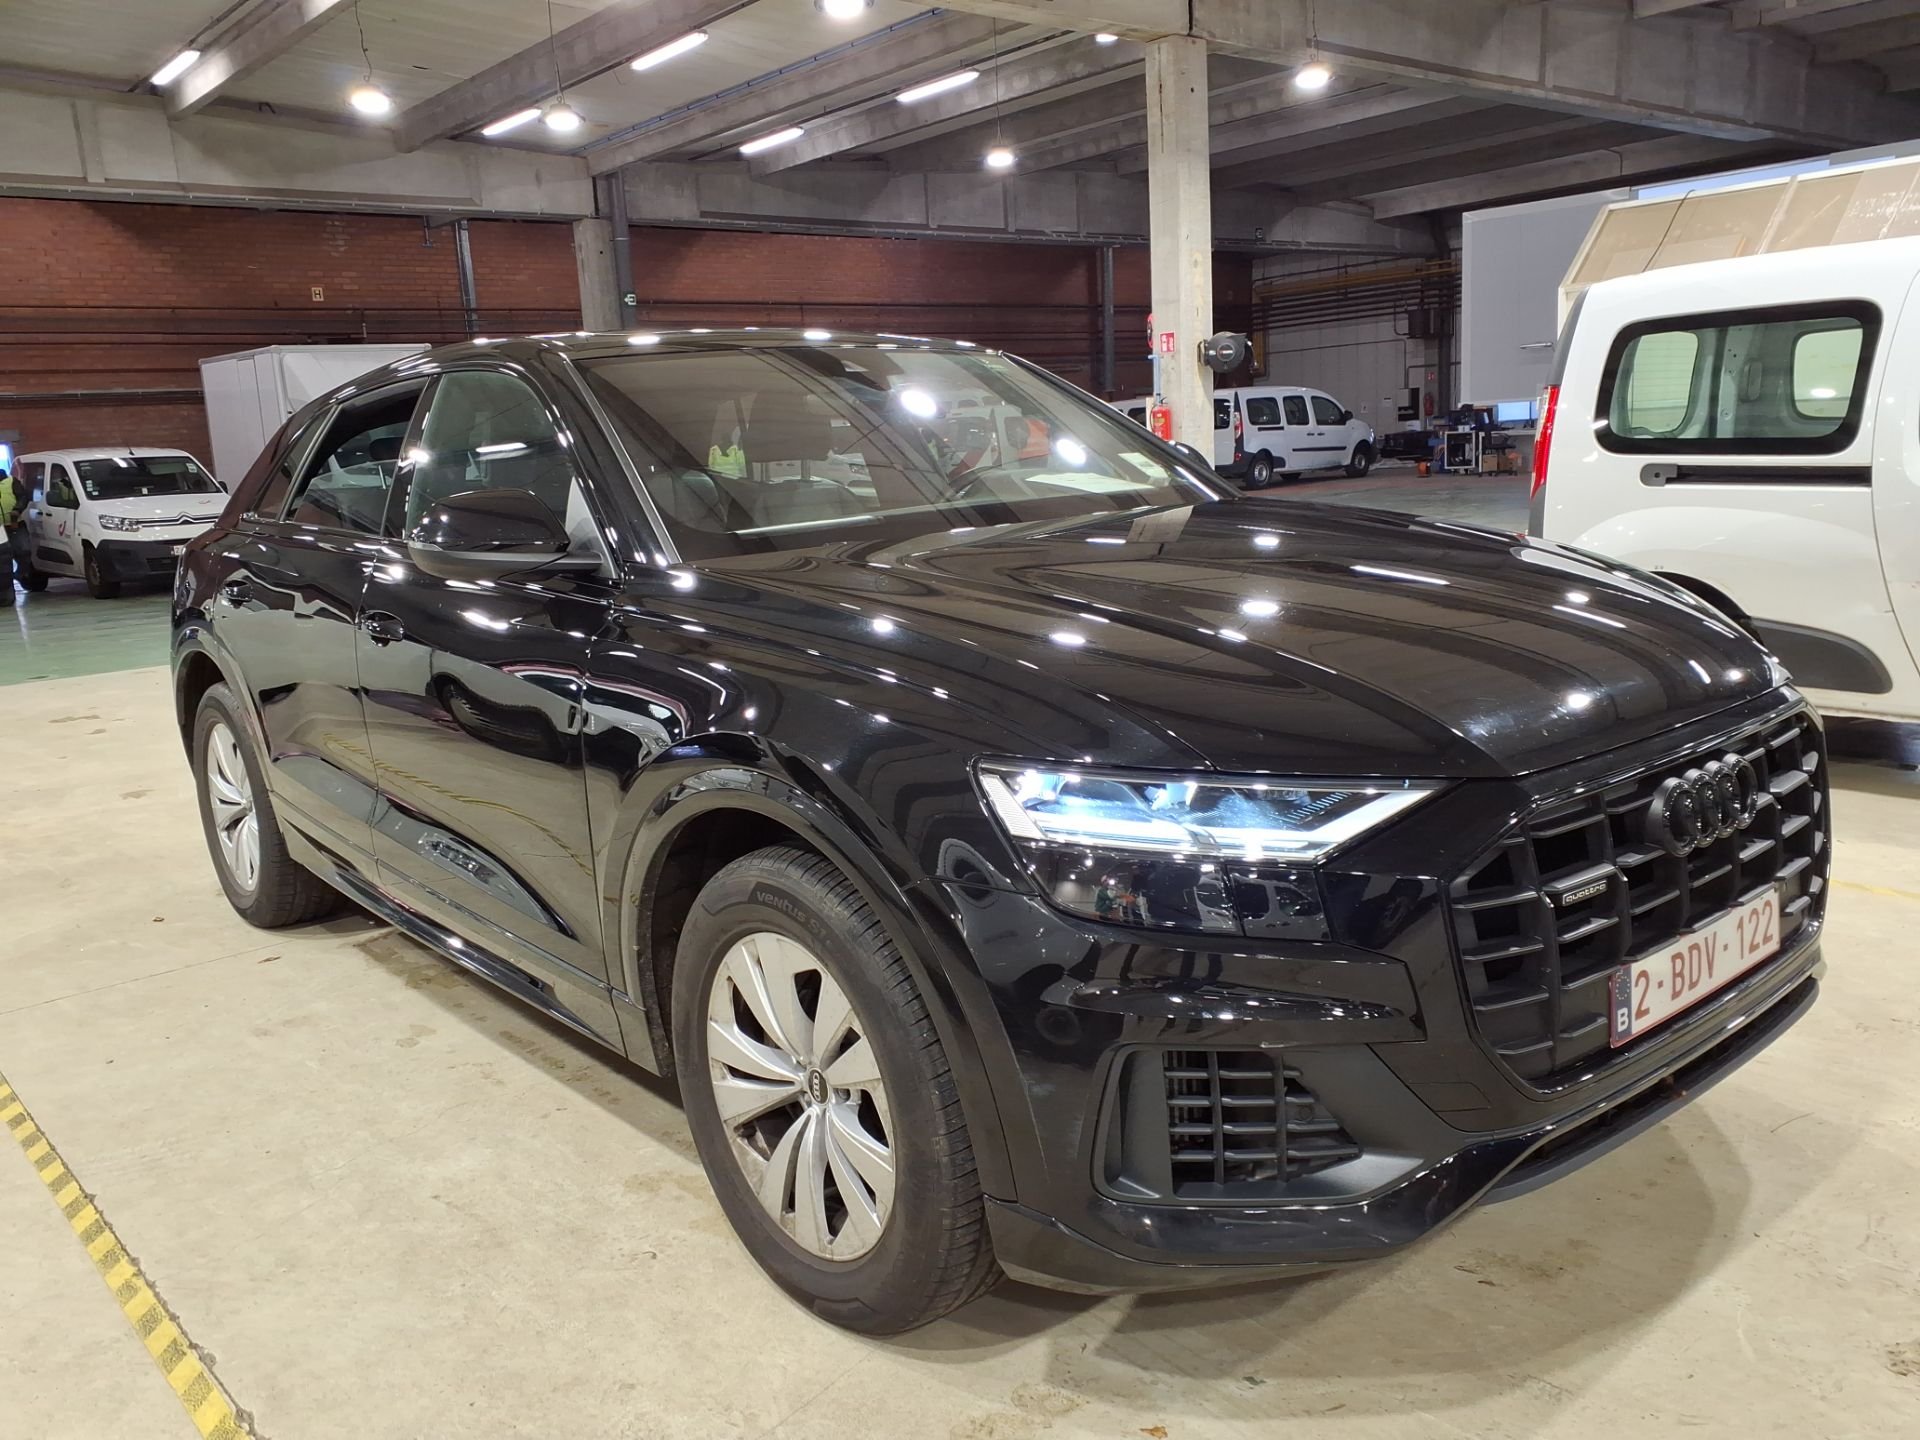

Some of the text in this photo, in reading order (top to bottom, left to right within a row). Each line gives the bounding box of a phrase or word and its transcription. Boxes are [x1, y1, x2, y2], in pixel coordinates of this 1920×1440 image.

[1565, 883, 1606, 902] quattro
[1634, 899, 1773, 1021] 2-BDV-122
[1617, 1007, 1629, 1033] B
